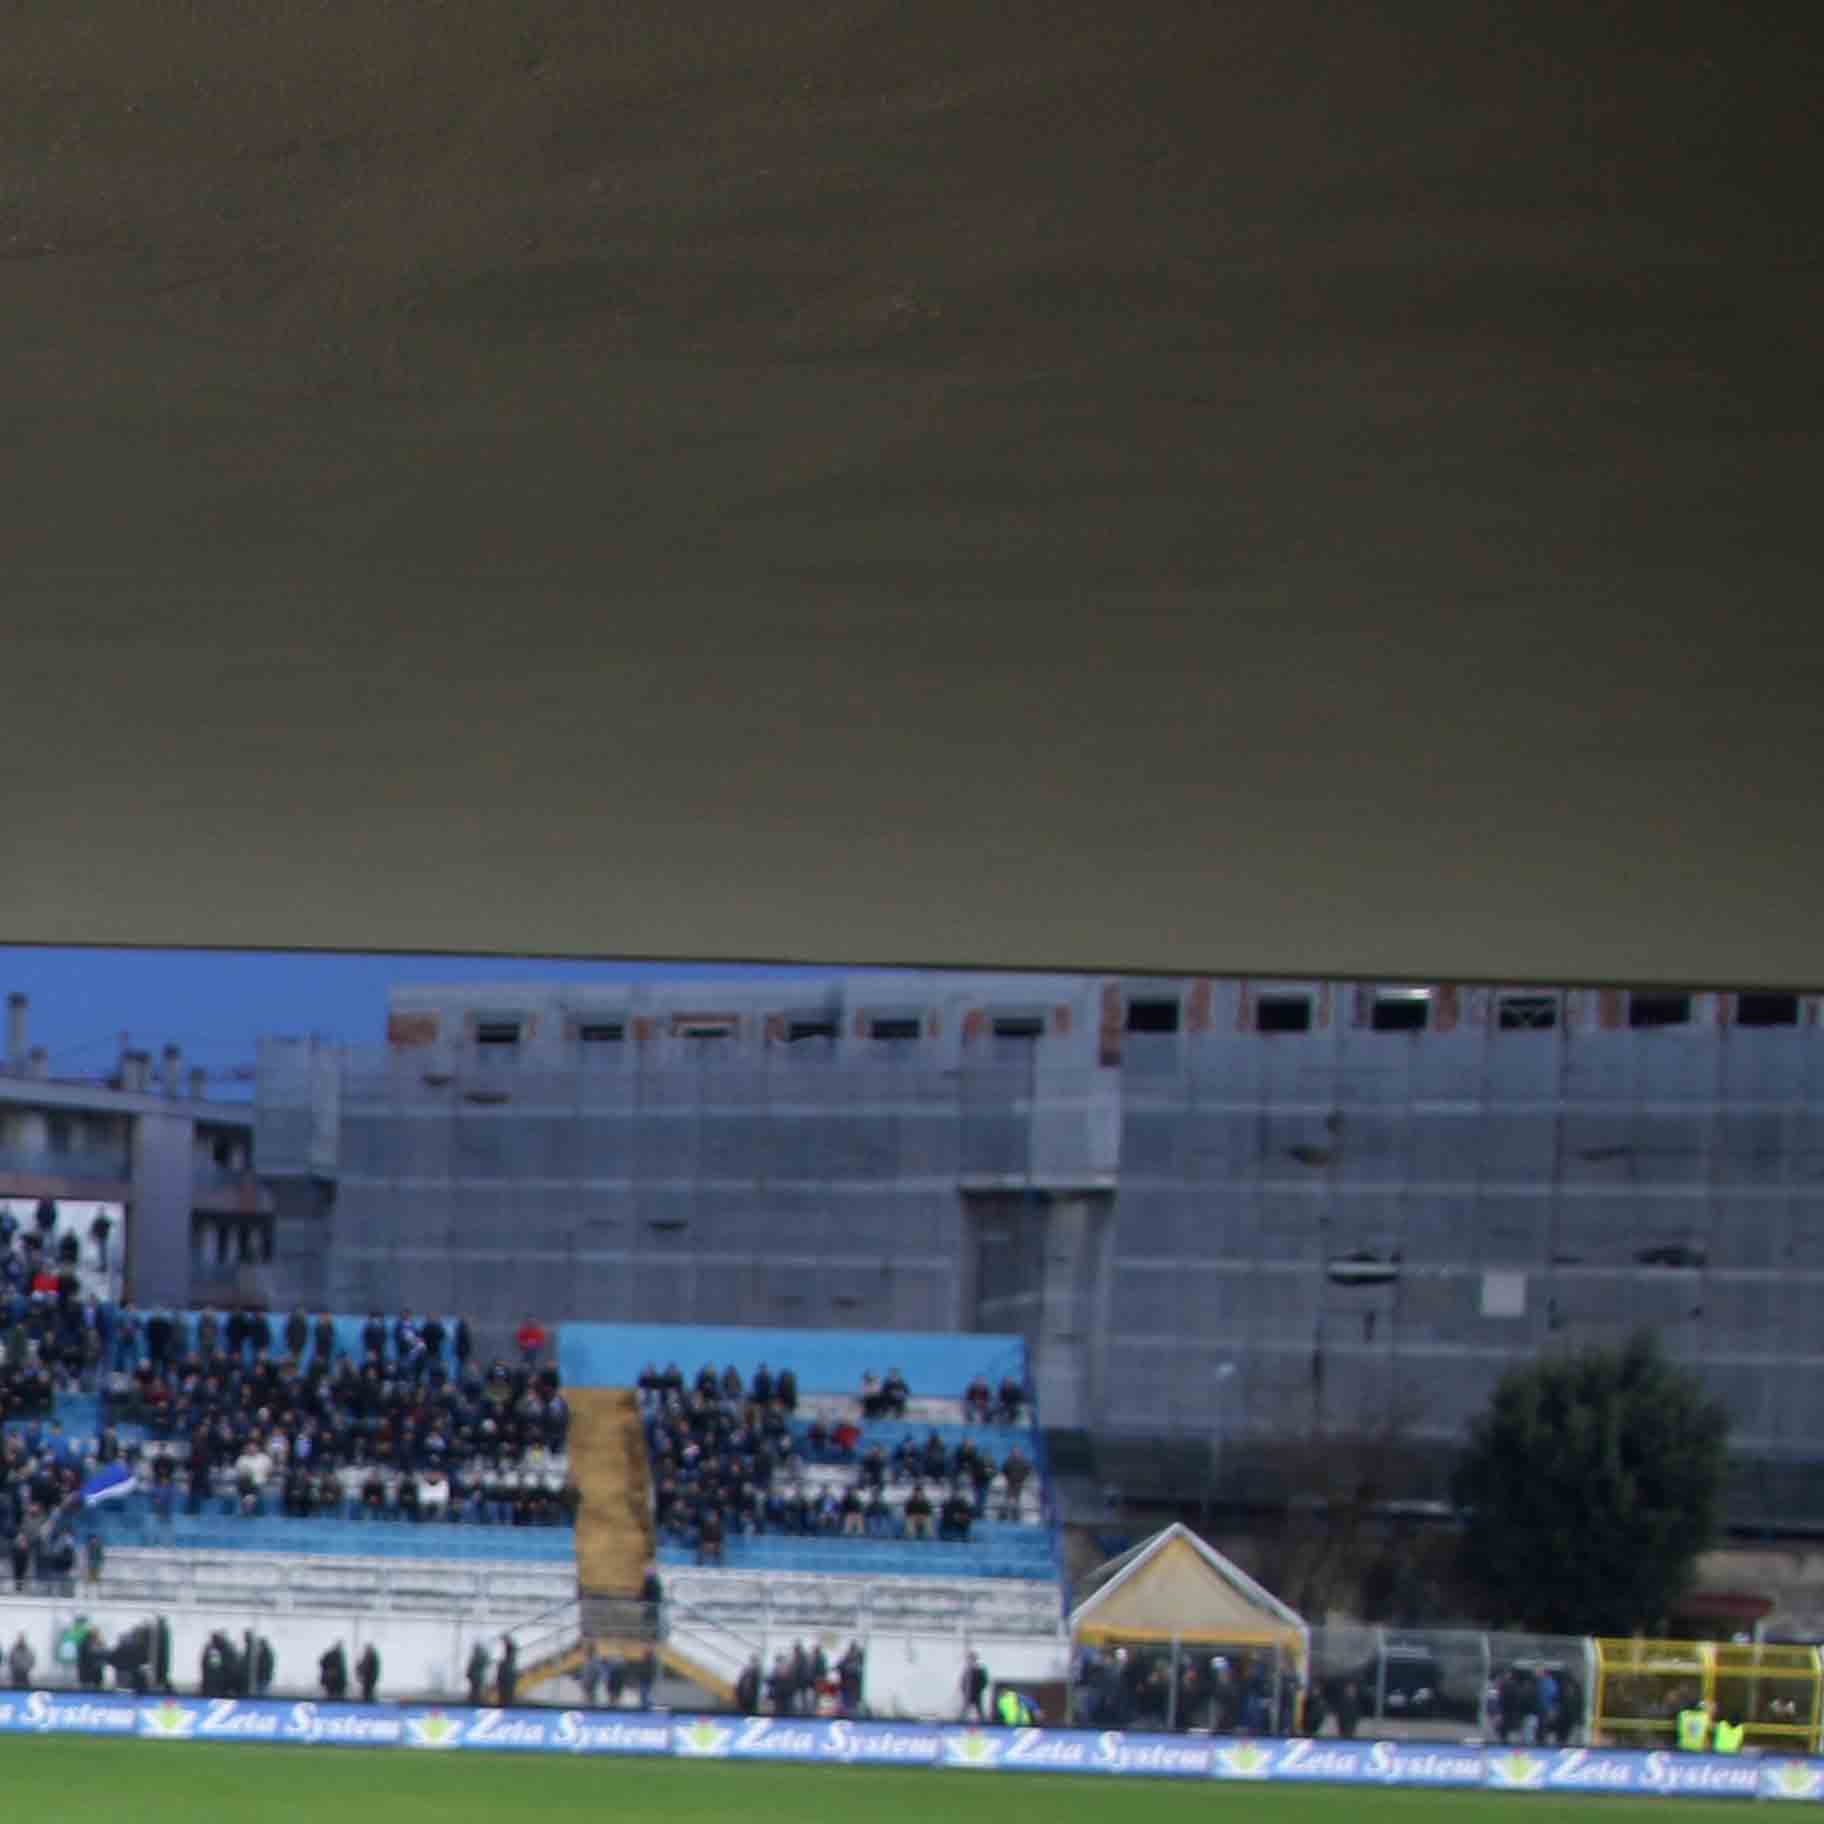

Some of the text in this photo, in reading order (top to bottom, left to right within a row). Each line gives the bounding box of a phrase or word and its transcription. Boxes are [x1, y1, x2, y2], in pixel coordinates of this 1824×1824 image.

[20, 1690, 134, 1731] System
[197, 1697, 403, 1740] Zeta System
[466, 1706, 667, 1751] Zeta System
[735, 1716, 937, 1761] Zeta System
[1005, 1727, 1208, 1771] Zeta System
[1275, 1738, 1487, 1783] Zeta System
[1549, 1747, 1754, 1793] Zeta System
